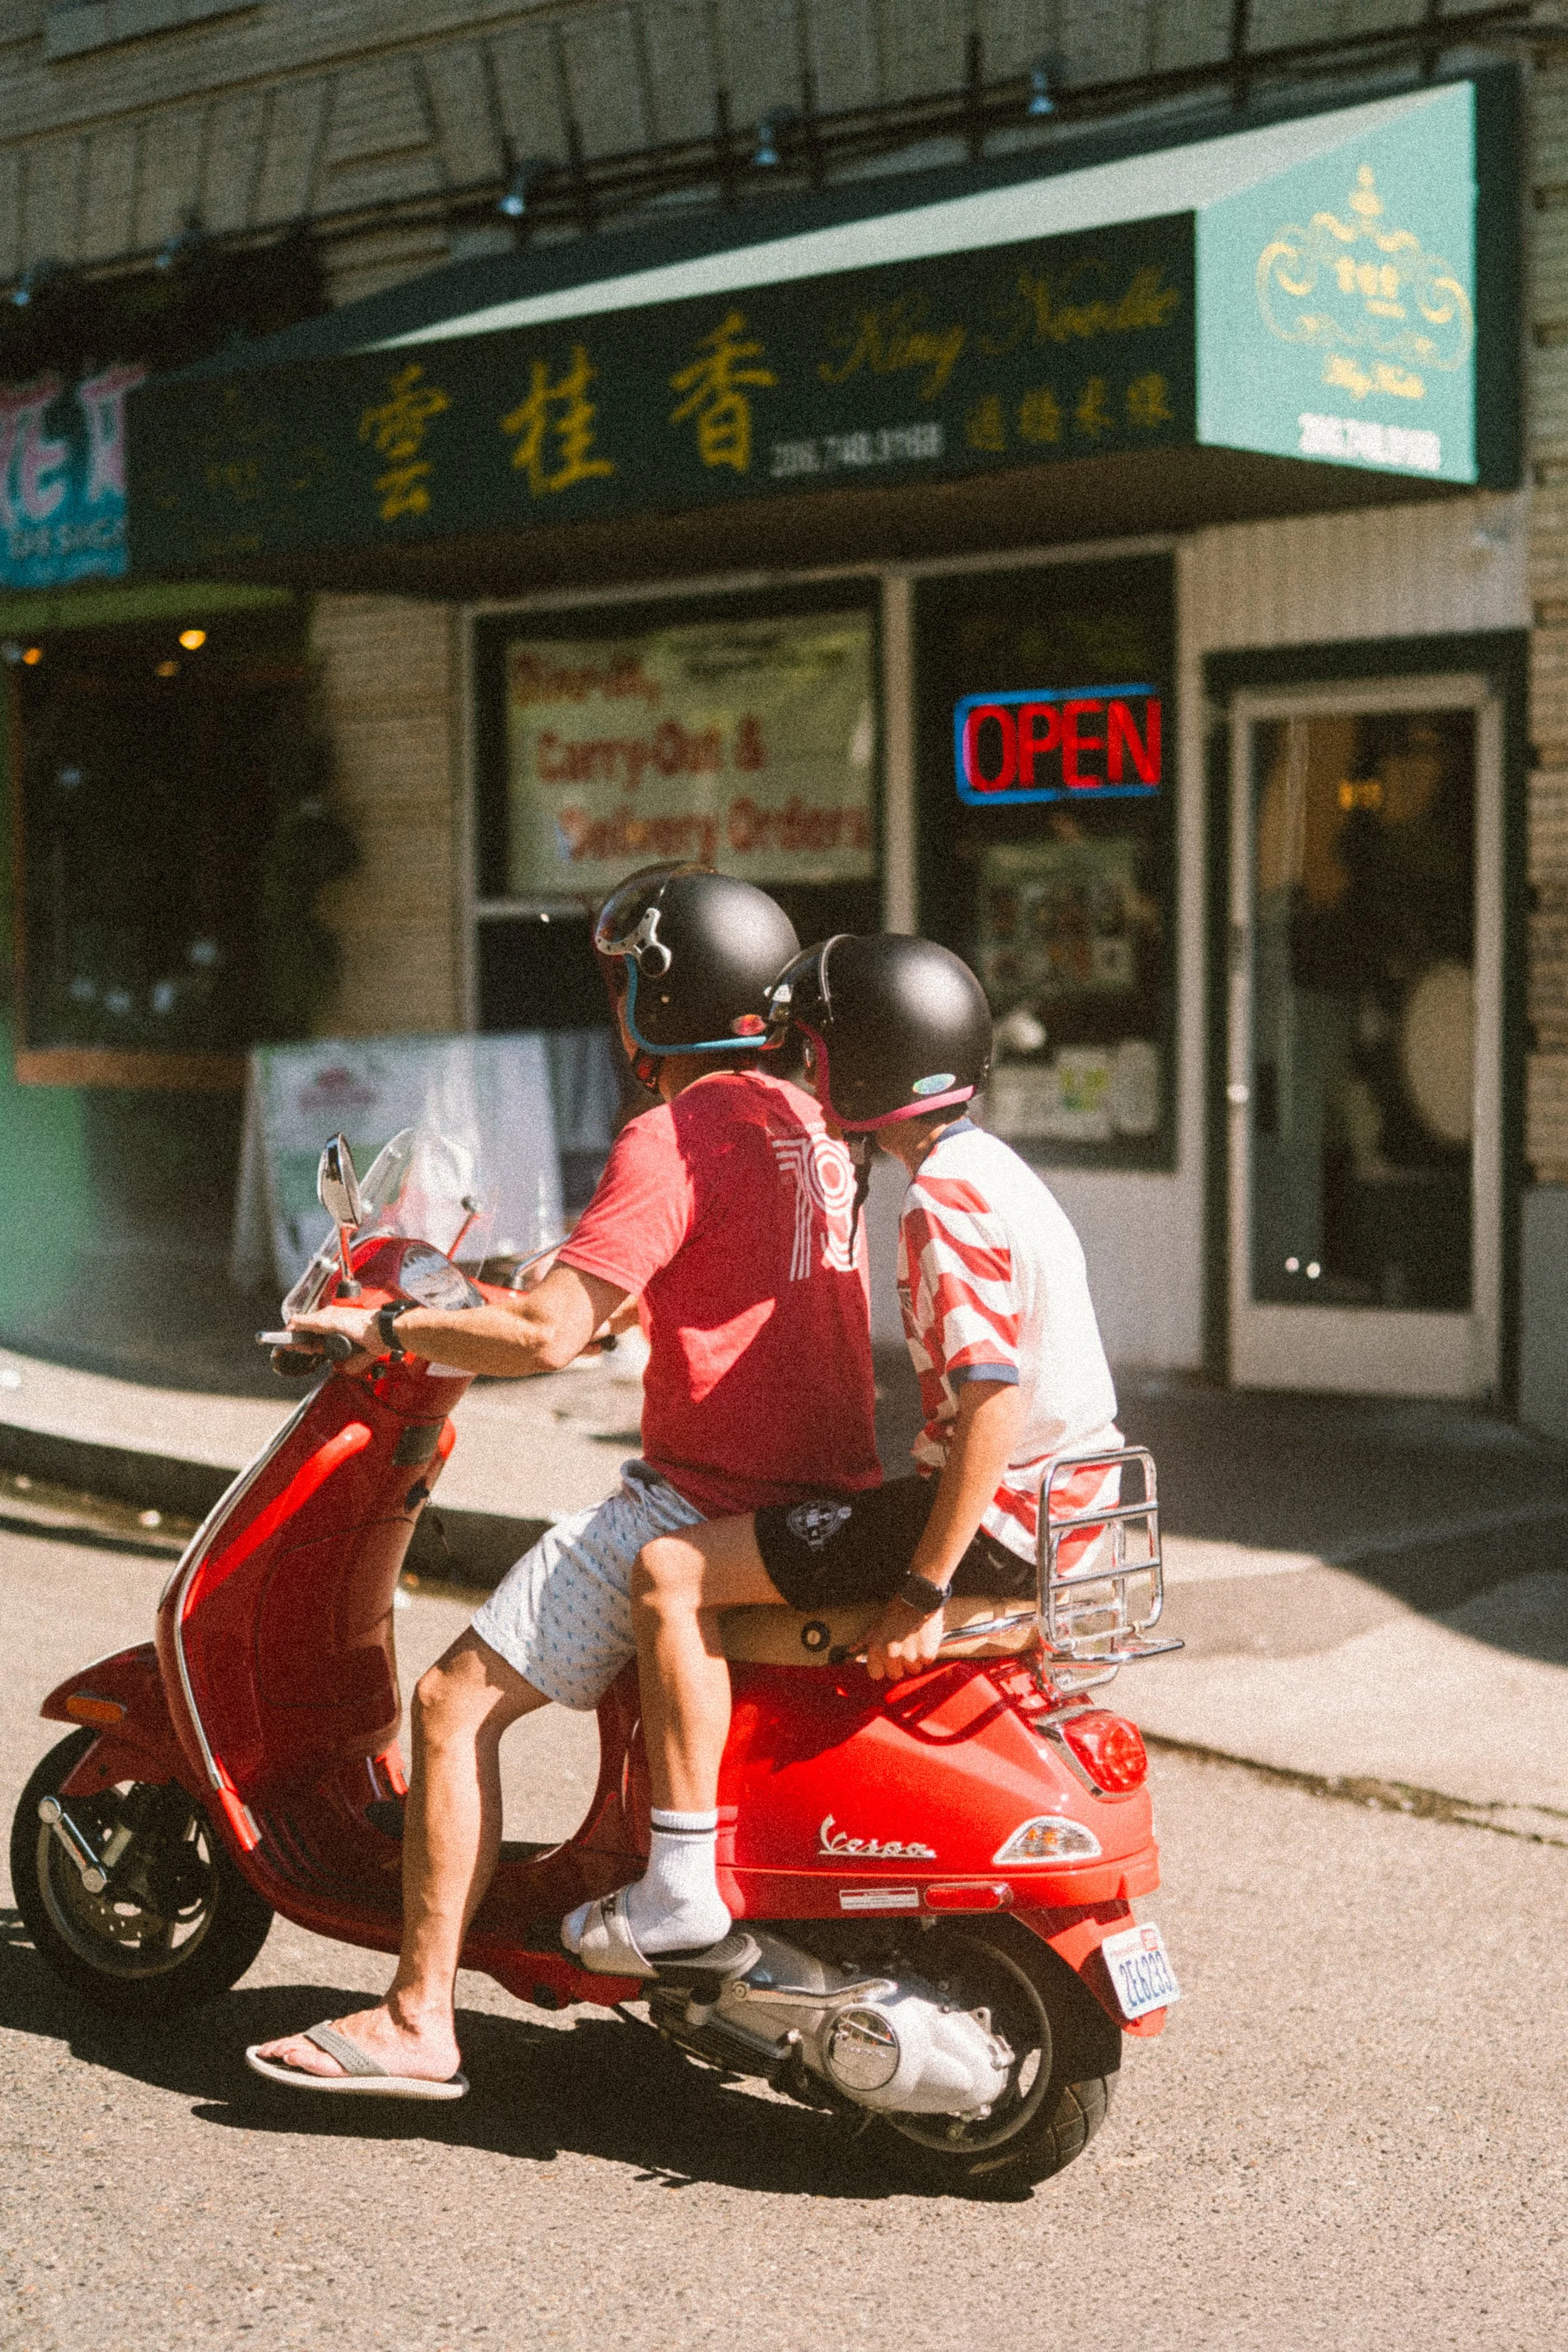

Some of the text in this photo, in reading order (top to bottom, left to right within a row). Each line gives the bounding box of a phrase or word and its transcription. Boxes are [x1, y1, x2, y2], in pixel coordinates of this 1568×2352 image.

[358, 310, 778, 521] 雲桂香
[962, 698, 1162, 793] OPEN
[818, 1814, 937, 1858] Vespa
